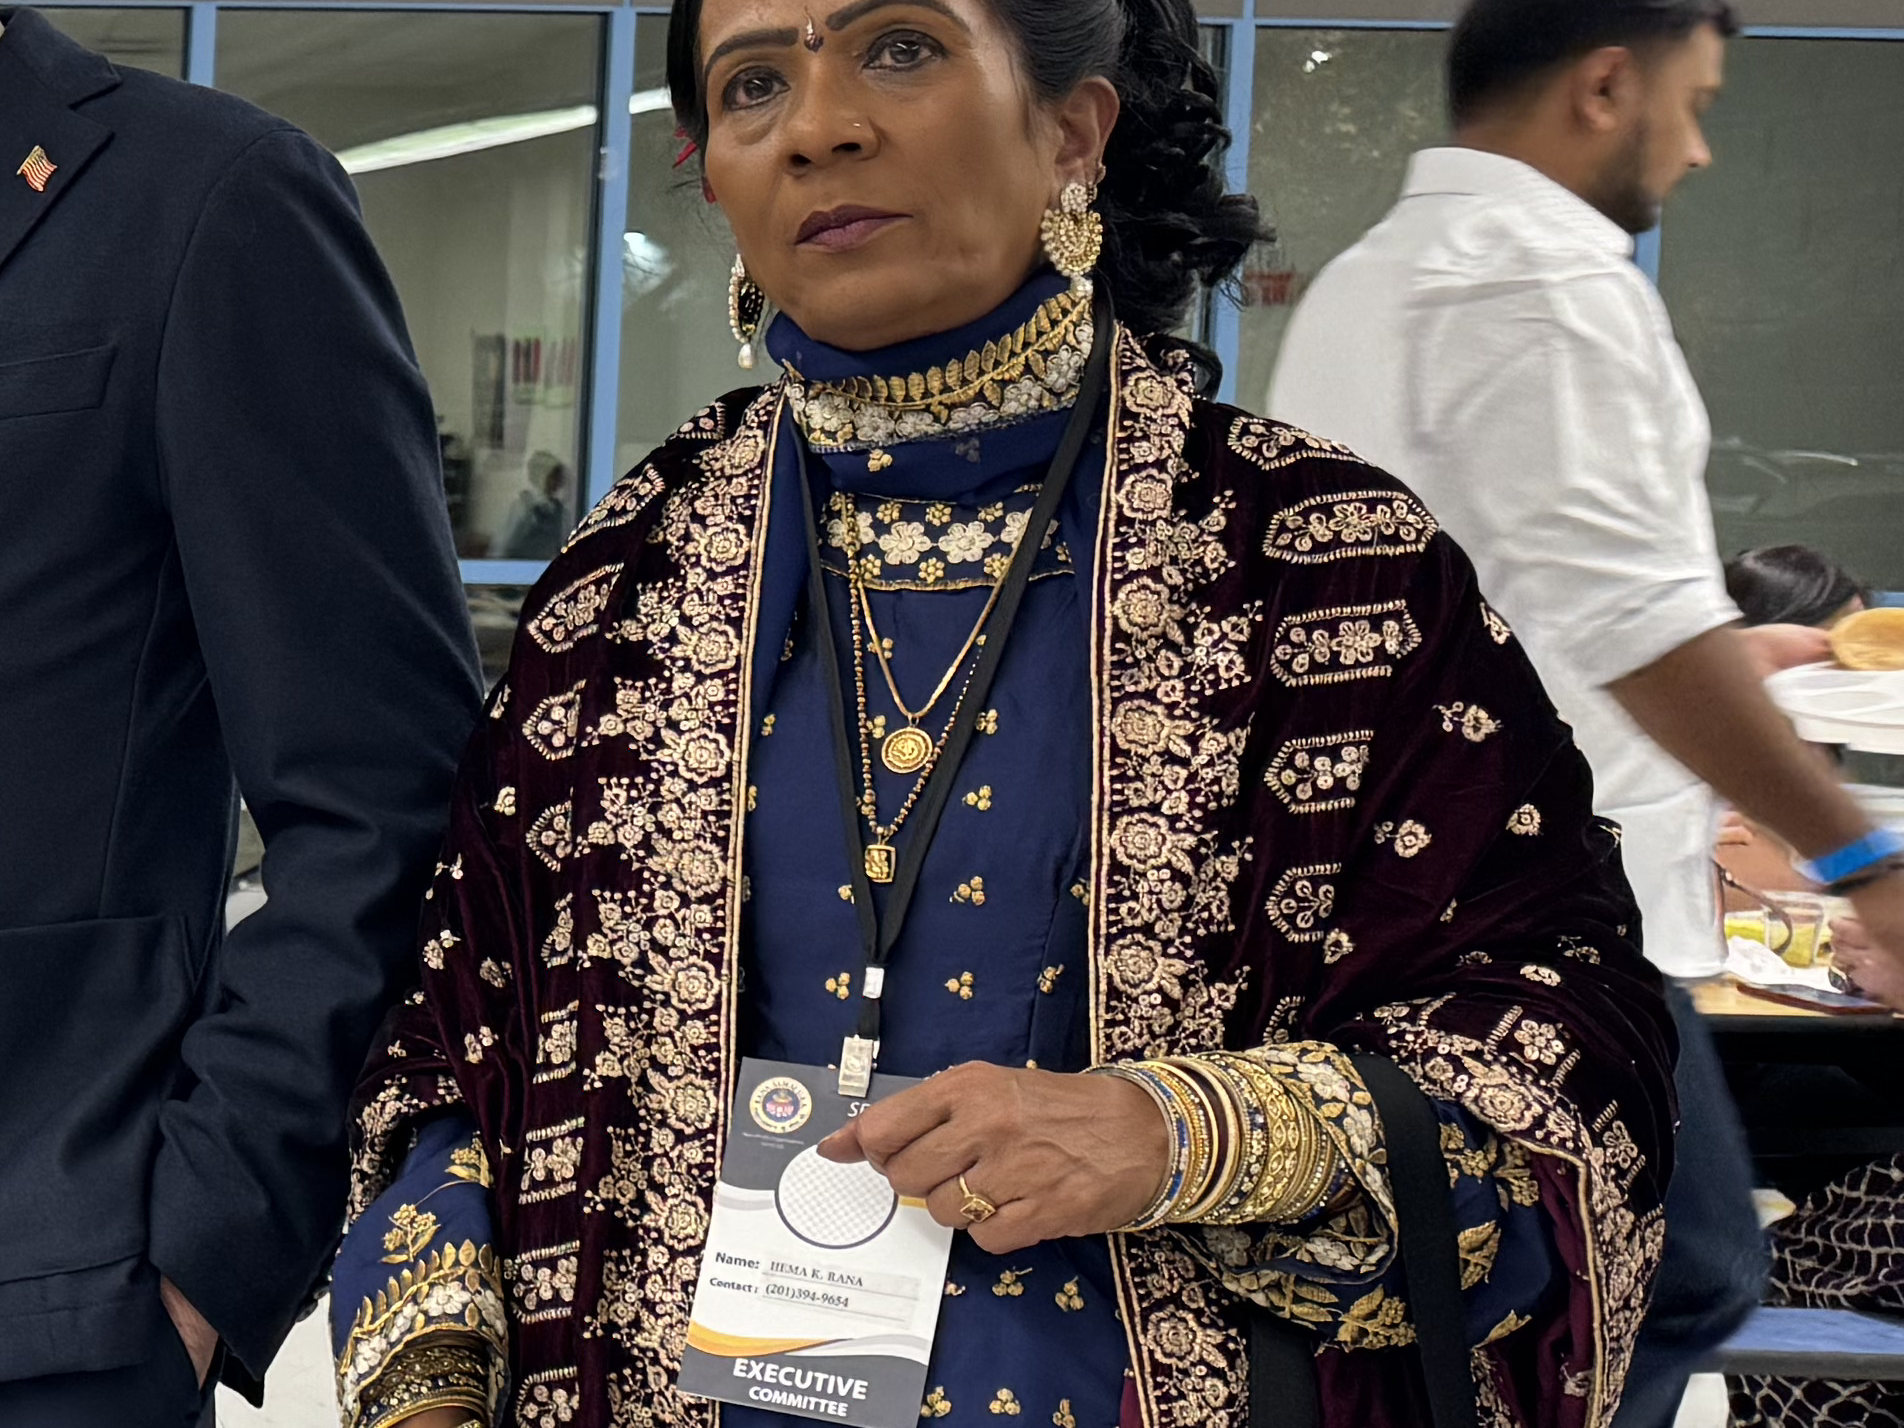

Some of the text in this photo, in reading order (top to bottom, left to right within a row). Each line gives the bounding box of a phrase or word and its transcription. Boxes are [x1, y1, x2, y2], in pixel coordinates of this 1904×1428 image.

[714, 1252, 760, 1270] Name:
[732, 1358, 869, 1401] EXECUTIVE
[748, 1386, 849, 1418] COMMITTEE
